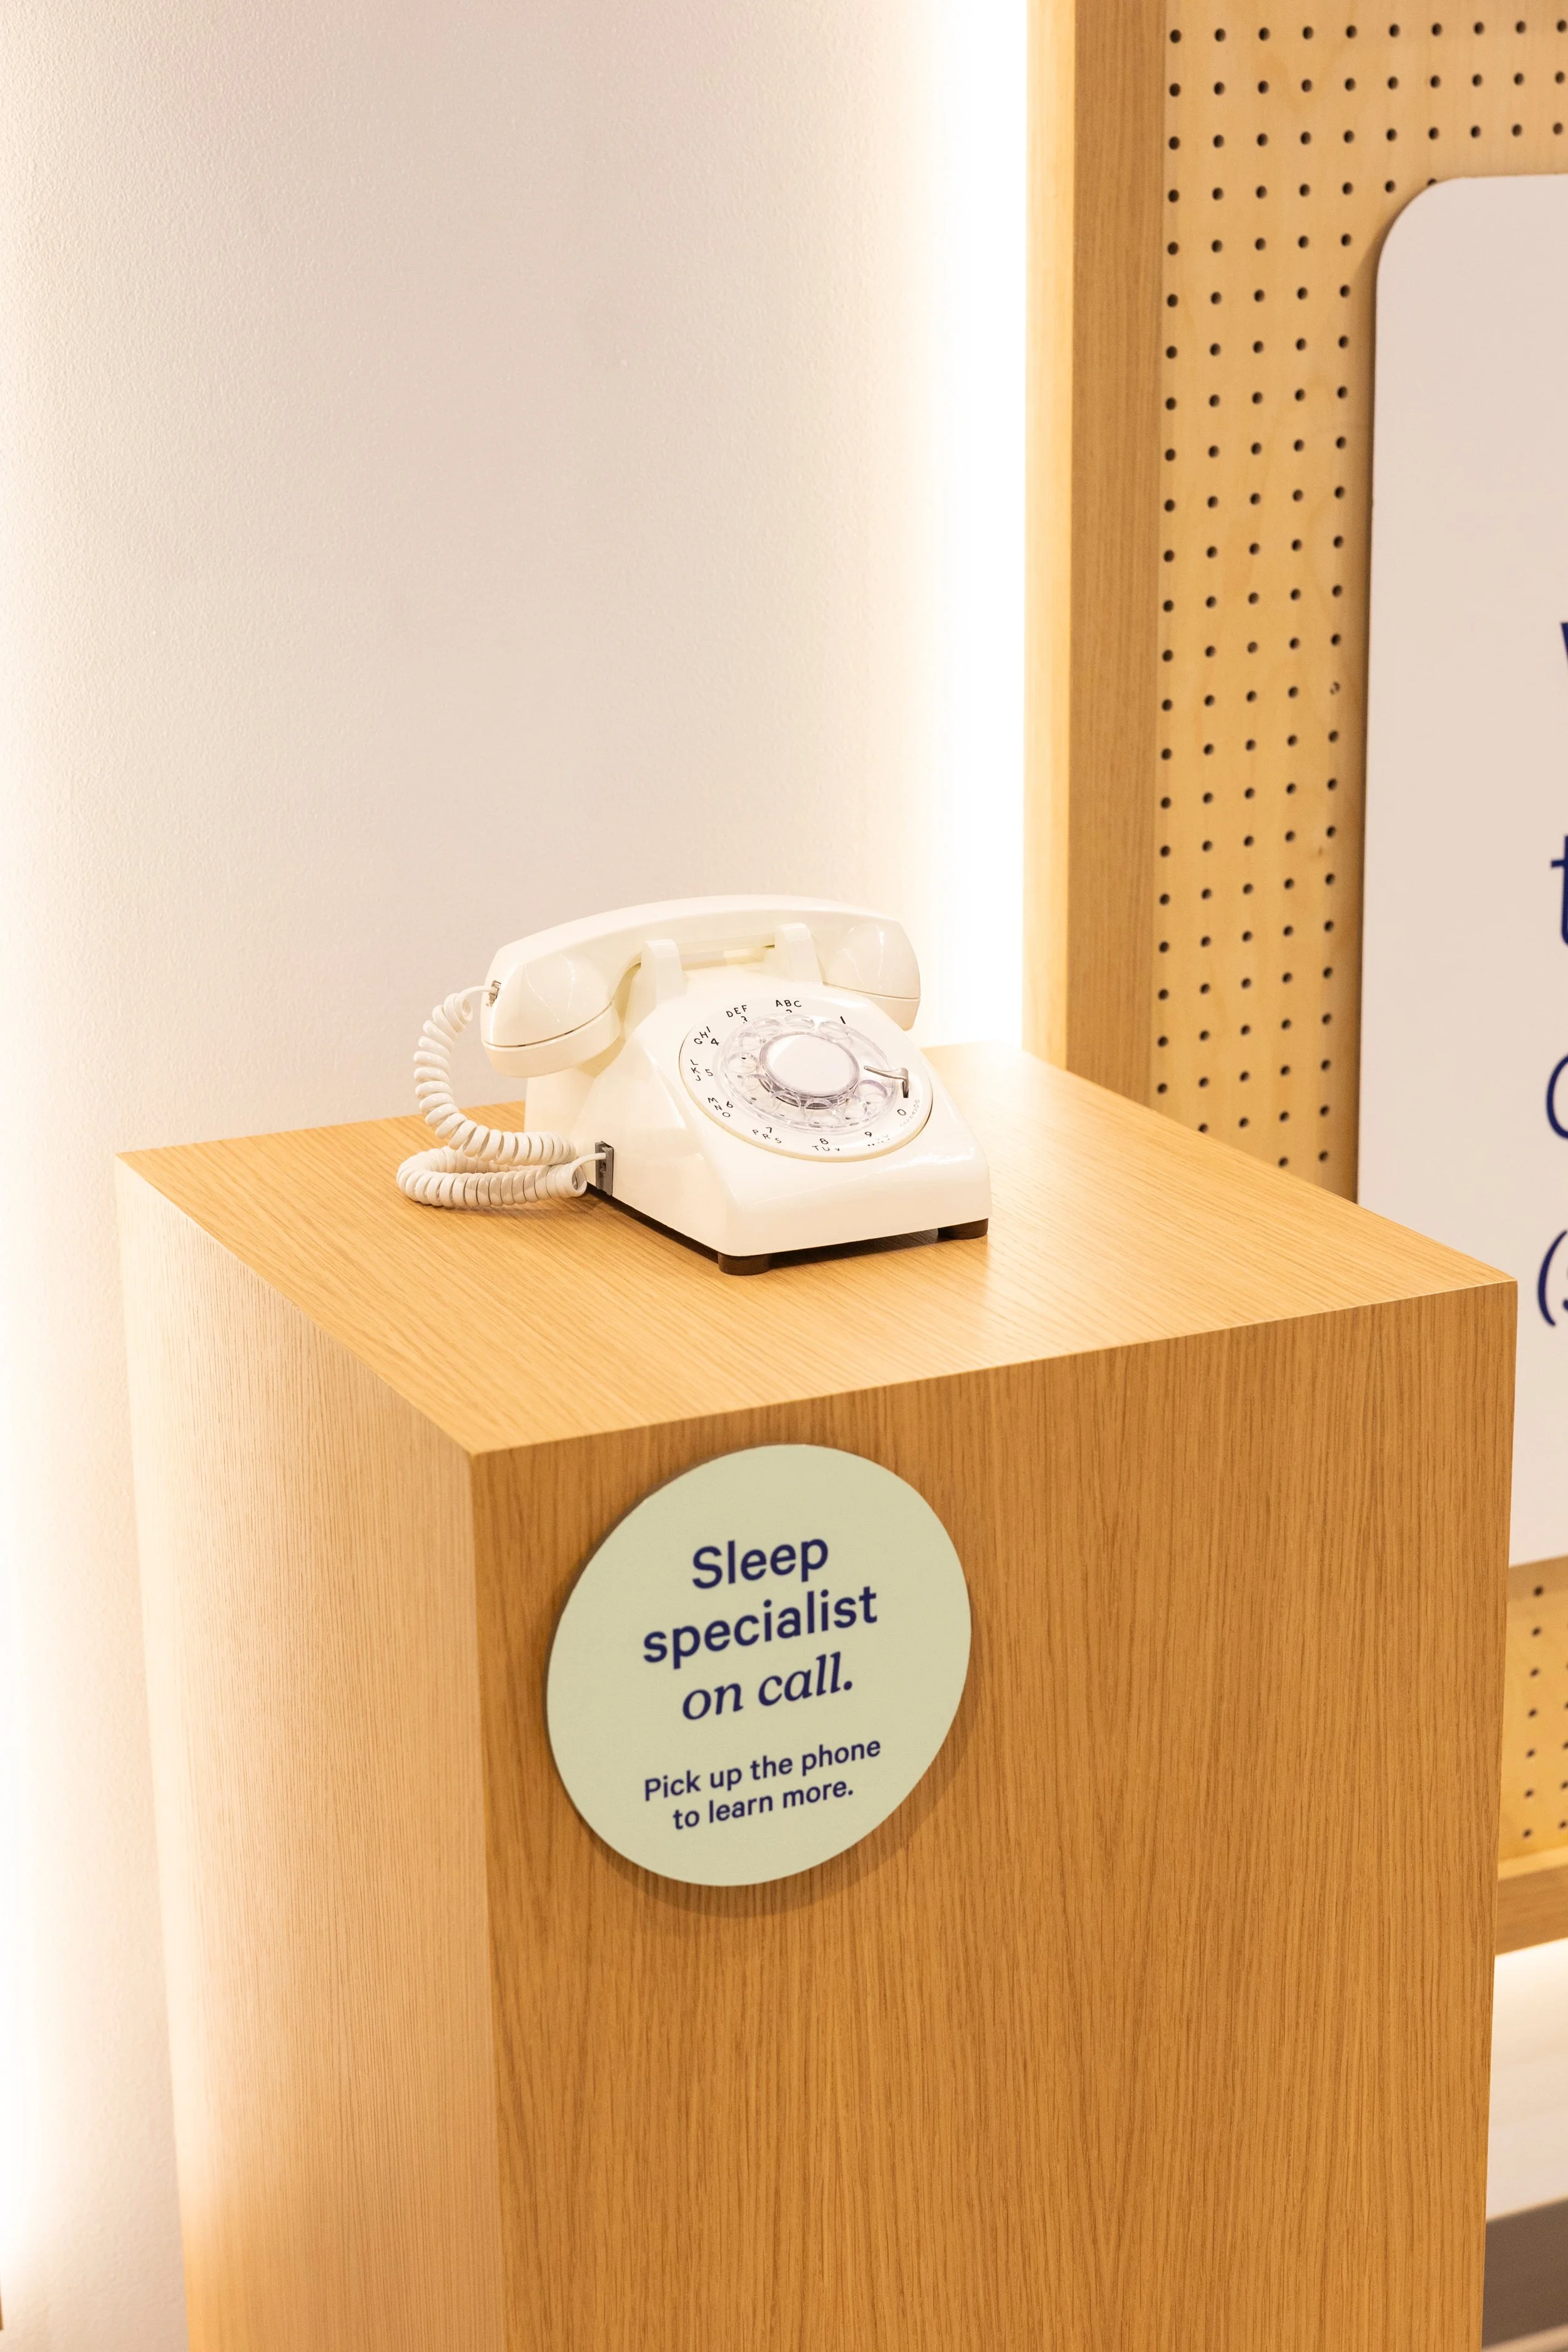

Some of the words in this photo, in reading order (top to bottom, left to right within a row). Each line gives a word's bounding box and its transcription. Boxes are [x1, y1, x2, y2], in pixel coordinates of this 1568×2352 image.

[726, 1004, 748, 1018] DEF
[775, 999, 802, 1008] ABC
[840, 1015, 846, 1025] 1
[694, 1026, 711, 1045] GHI
[711, 1038, 719, 1046] 4
[705, 1069, 714, 1077] 5
[707, 1097, 731, 1118] MNO
[726, 1101, 734, 1109] 6
[752, 1129, 782, 1145] PRS
[692, 1538, 829, 1590] Sleep
[643, 1586, 878, 1670] specialist
[682, 1682, 744, 1721] on
[758, 1651, 854, 1707] call.
[644, 1769, 702, 1803] Pick
[709, 1767, 743, 1792] up
[750, 1754, 793, 1781] the
[801, 1740, 881, 1777] phone
[672, 1809, 701, 1830] to
[708, 1795, 774, 1824] learn
[782, 1780, 854, 1809] more.
